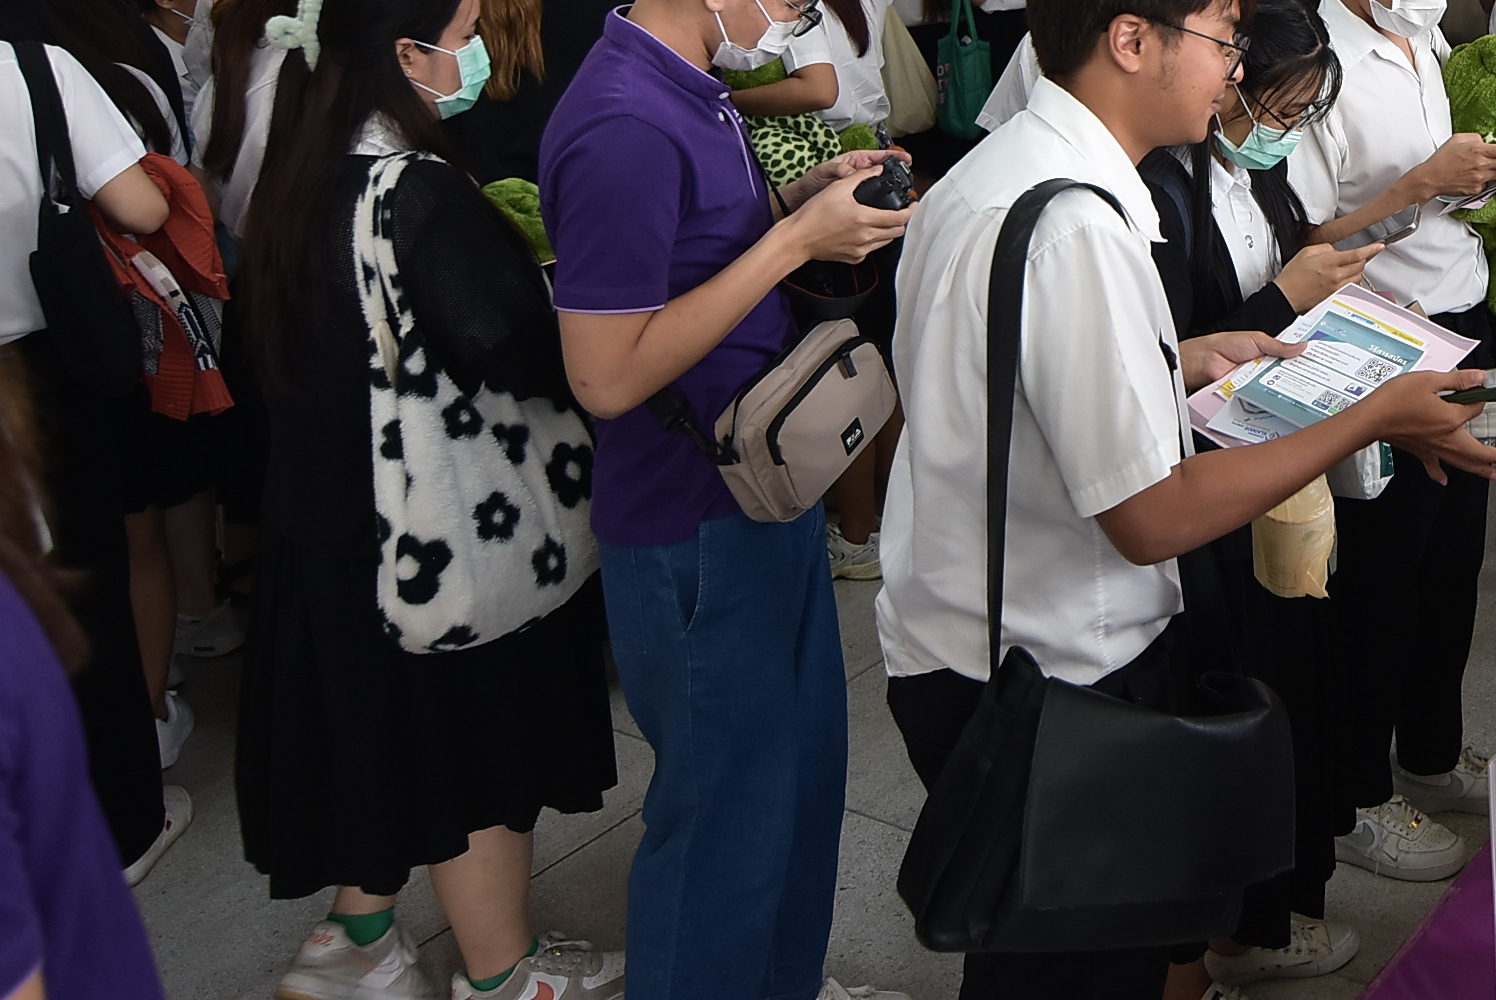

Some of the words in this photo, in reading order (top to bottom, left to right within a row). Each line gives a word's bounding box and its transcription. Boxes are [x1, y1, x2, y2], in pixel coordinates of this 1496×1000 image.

[1368, 344, 1408, 366] วิธีการสมัคร
